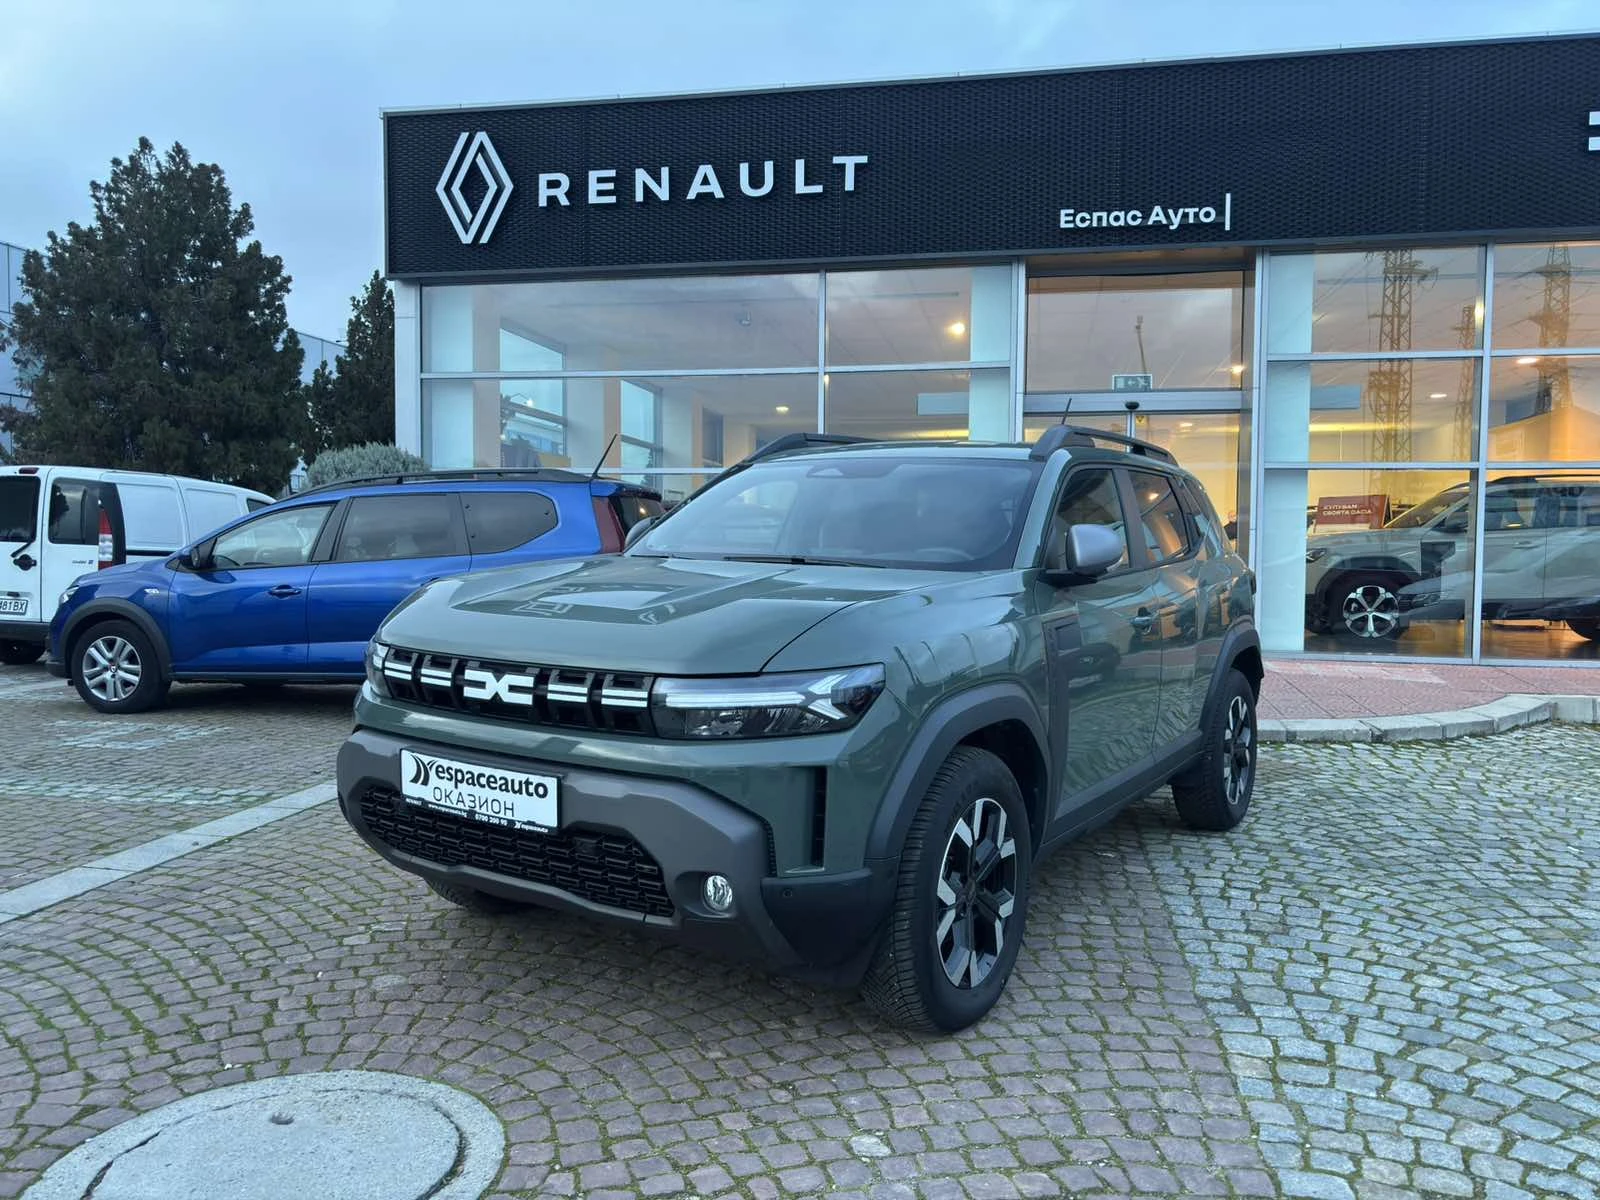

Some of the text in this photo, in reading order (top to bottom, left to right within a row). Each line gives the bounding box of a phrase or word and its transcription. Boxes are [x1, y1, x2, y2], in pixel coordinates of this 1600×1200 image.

[538, 155, 869, 207] RENAULT
[1059, 205, 1217, 230] Еспас Ауто
[435, 763, 549, 799] espaceauto
[432, 786, 515, 818] ОКАЗИОН
